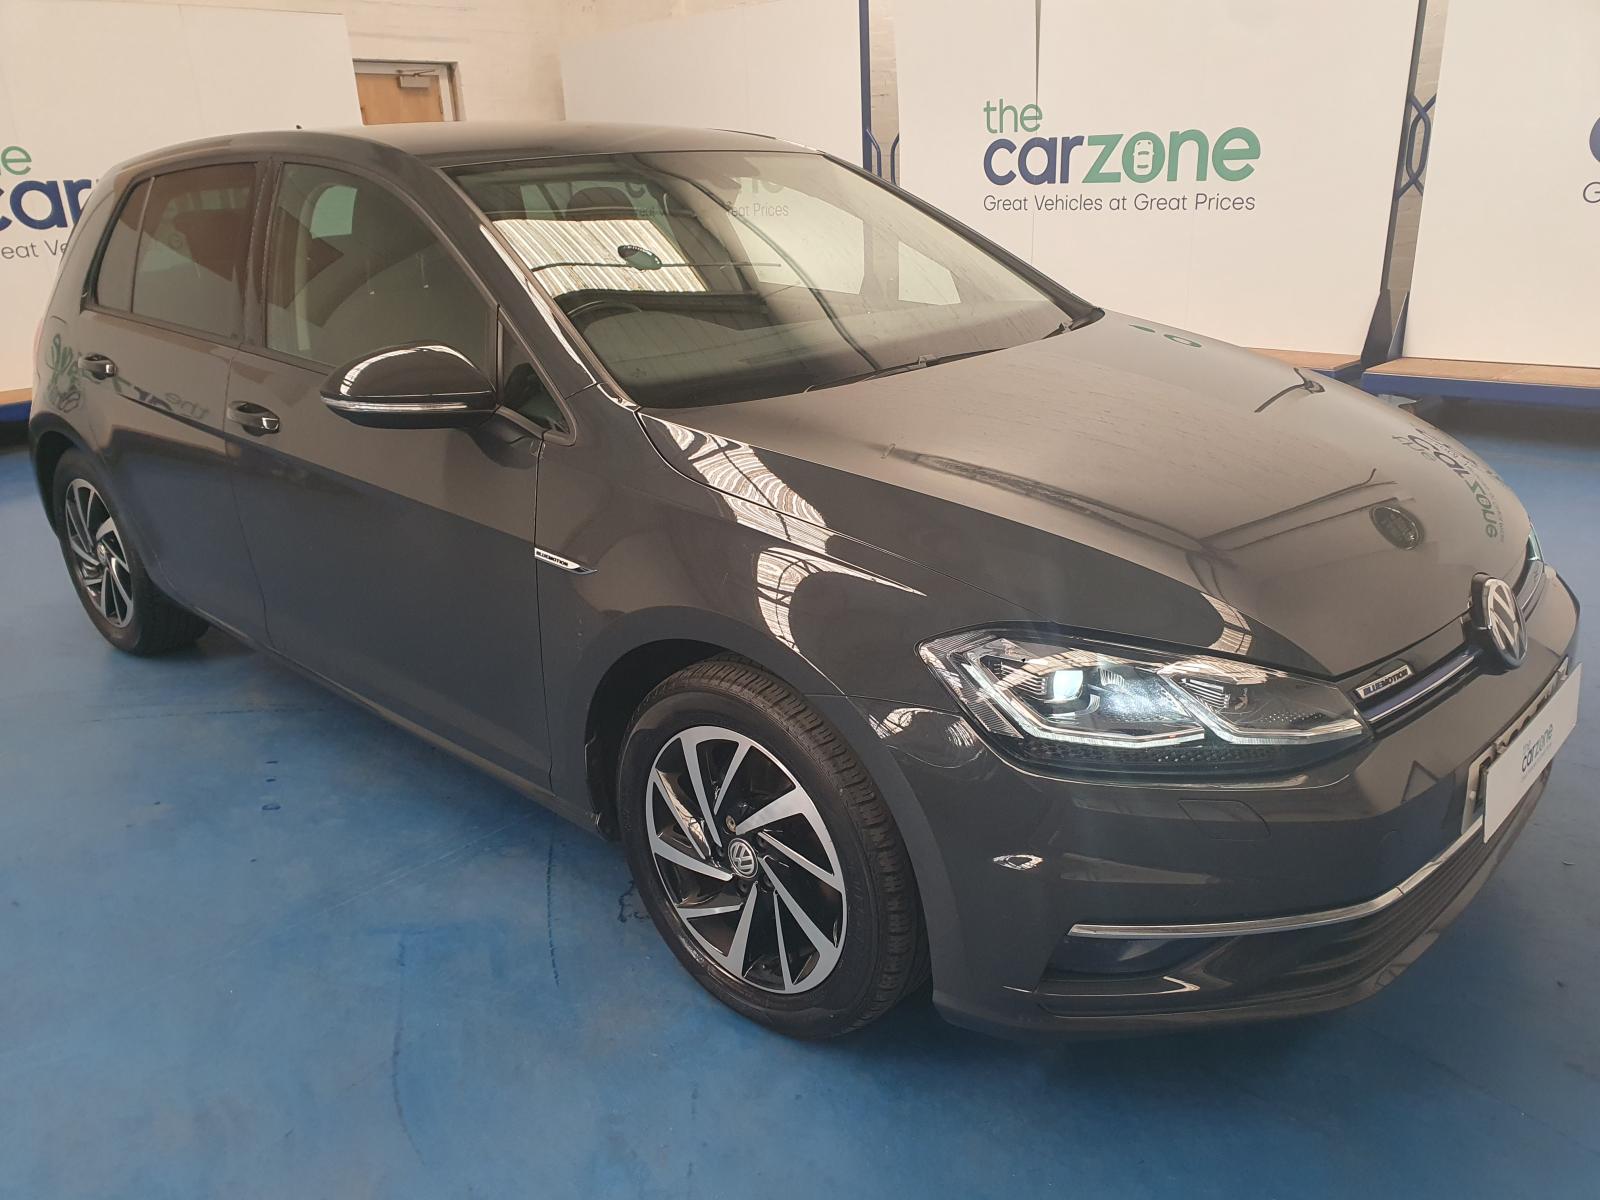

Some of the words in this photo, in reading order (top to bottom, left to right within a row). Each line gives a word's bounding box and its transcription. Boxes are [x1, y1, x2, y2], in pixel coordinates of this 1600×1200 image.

[983, 98, 1043, 134] the
[983, 127, 1261, 186] carzone
[753, 203, 789, 217] Prices
[983, 195, 1028, 211] Great
[1034, 194, 1103, 211] Vehicles
[1109, 195, 1127, 211] at
[1134, 193, 1187, 211] Great
[1194, 193, 1256, 211] Prices
[1363, 668, 1409, 696] BLUEMOTION
